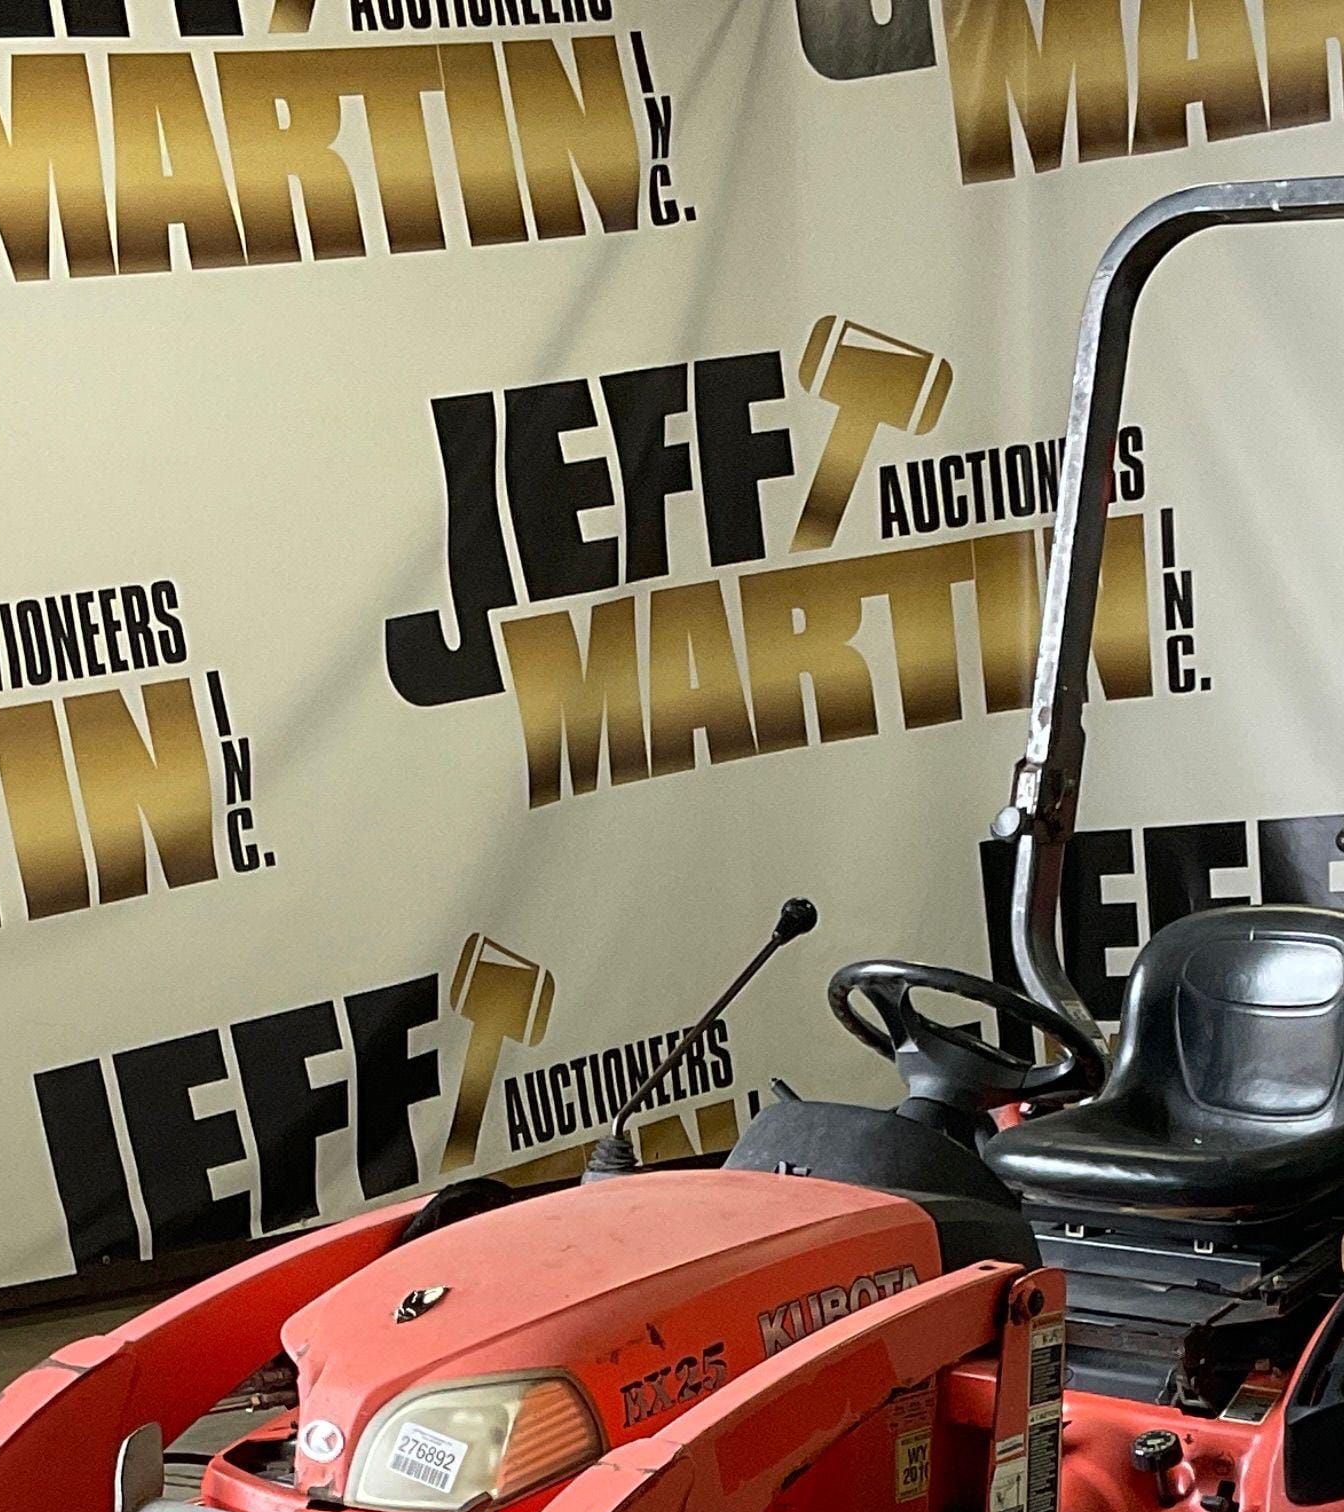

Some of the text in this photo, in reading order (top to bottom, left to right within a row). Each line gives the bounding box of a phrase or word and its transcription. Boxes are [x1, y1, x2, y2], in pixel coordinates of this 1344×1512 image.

[629, 31, 696, 226] INC.
[386, 351, 794, 707] JEFF
[879, 426, 1145, 540] AUCTIONS
[1160, 507, 1212, 693] INC.
[206, 670, 276, 874] INC.
[504, 1019, 734, 1152] AUCTIONEERS
[398, 1435, 456, 1471] 276892
[619, 1341, 729, 1429] BX25
